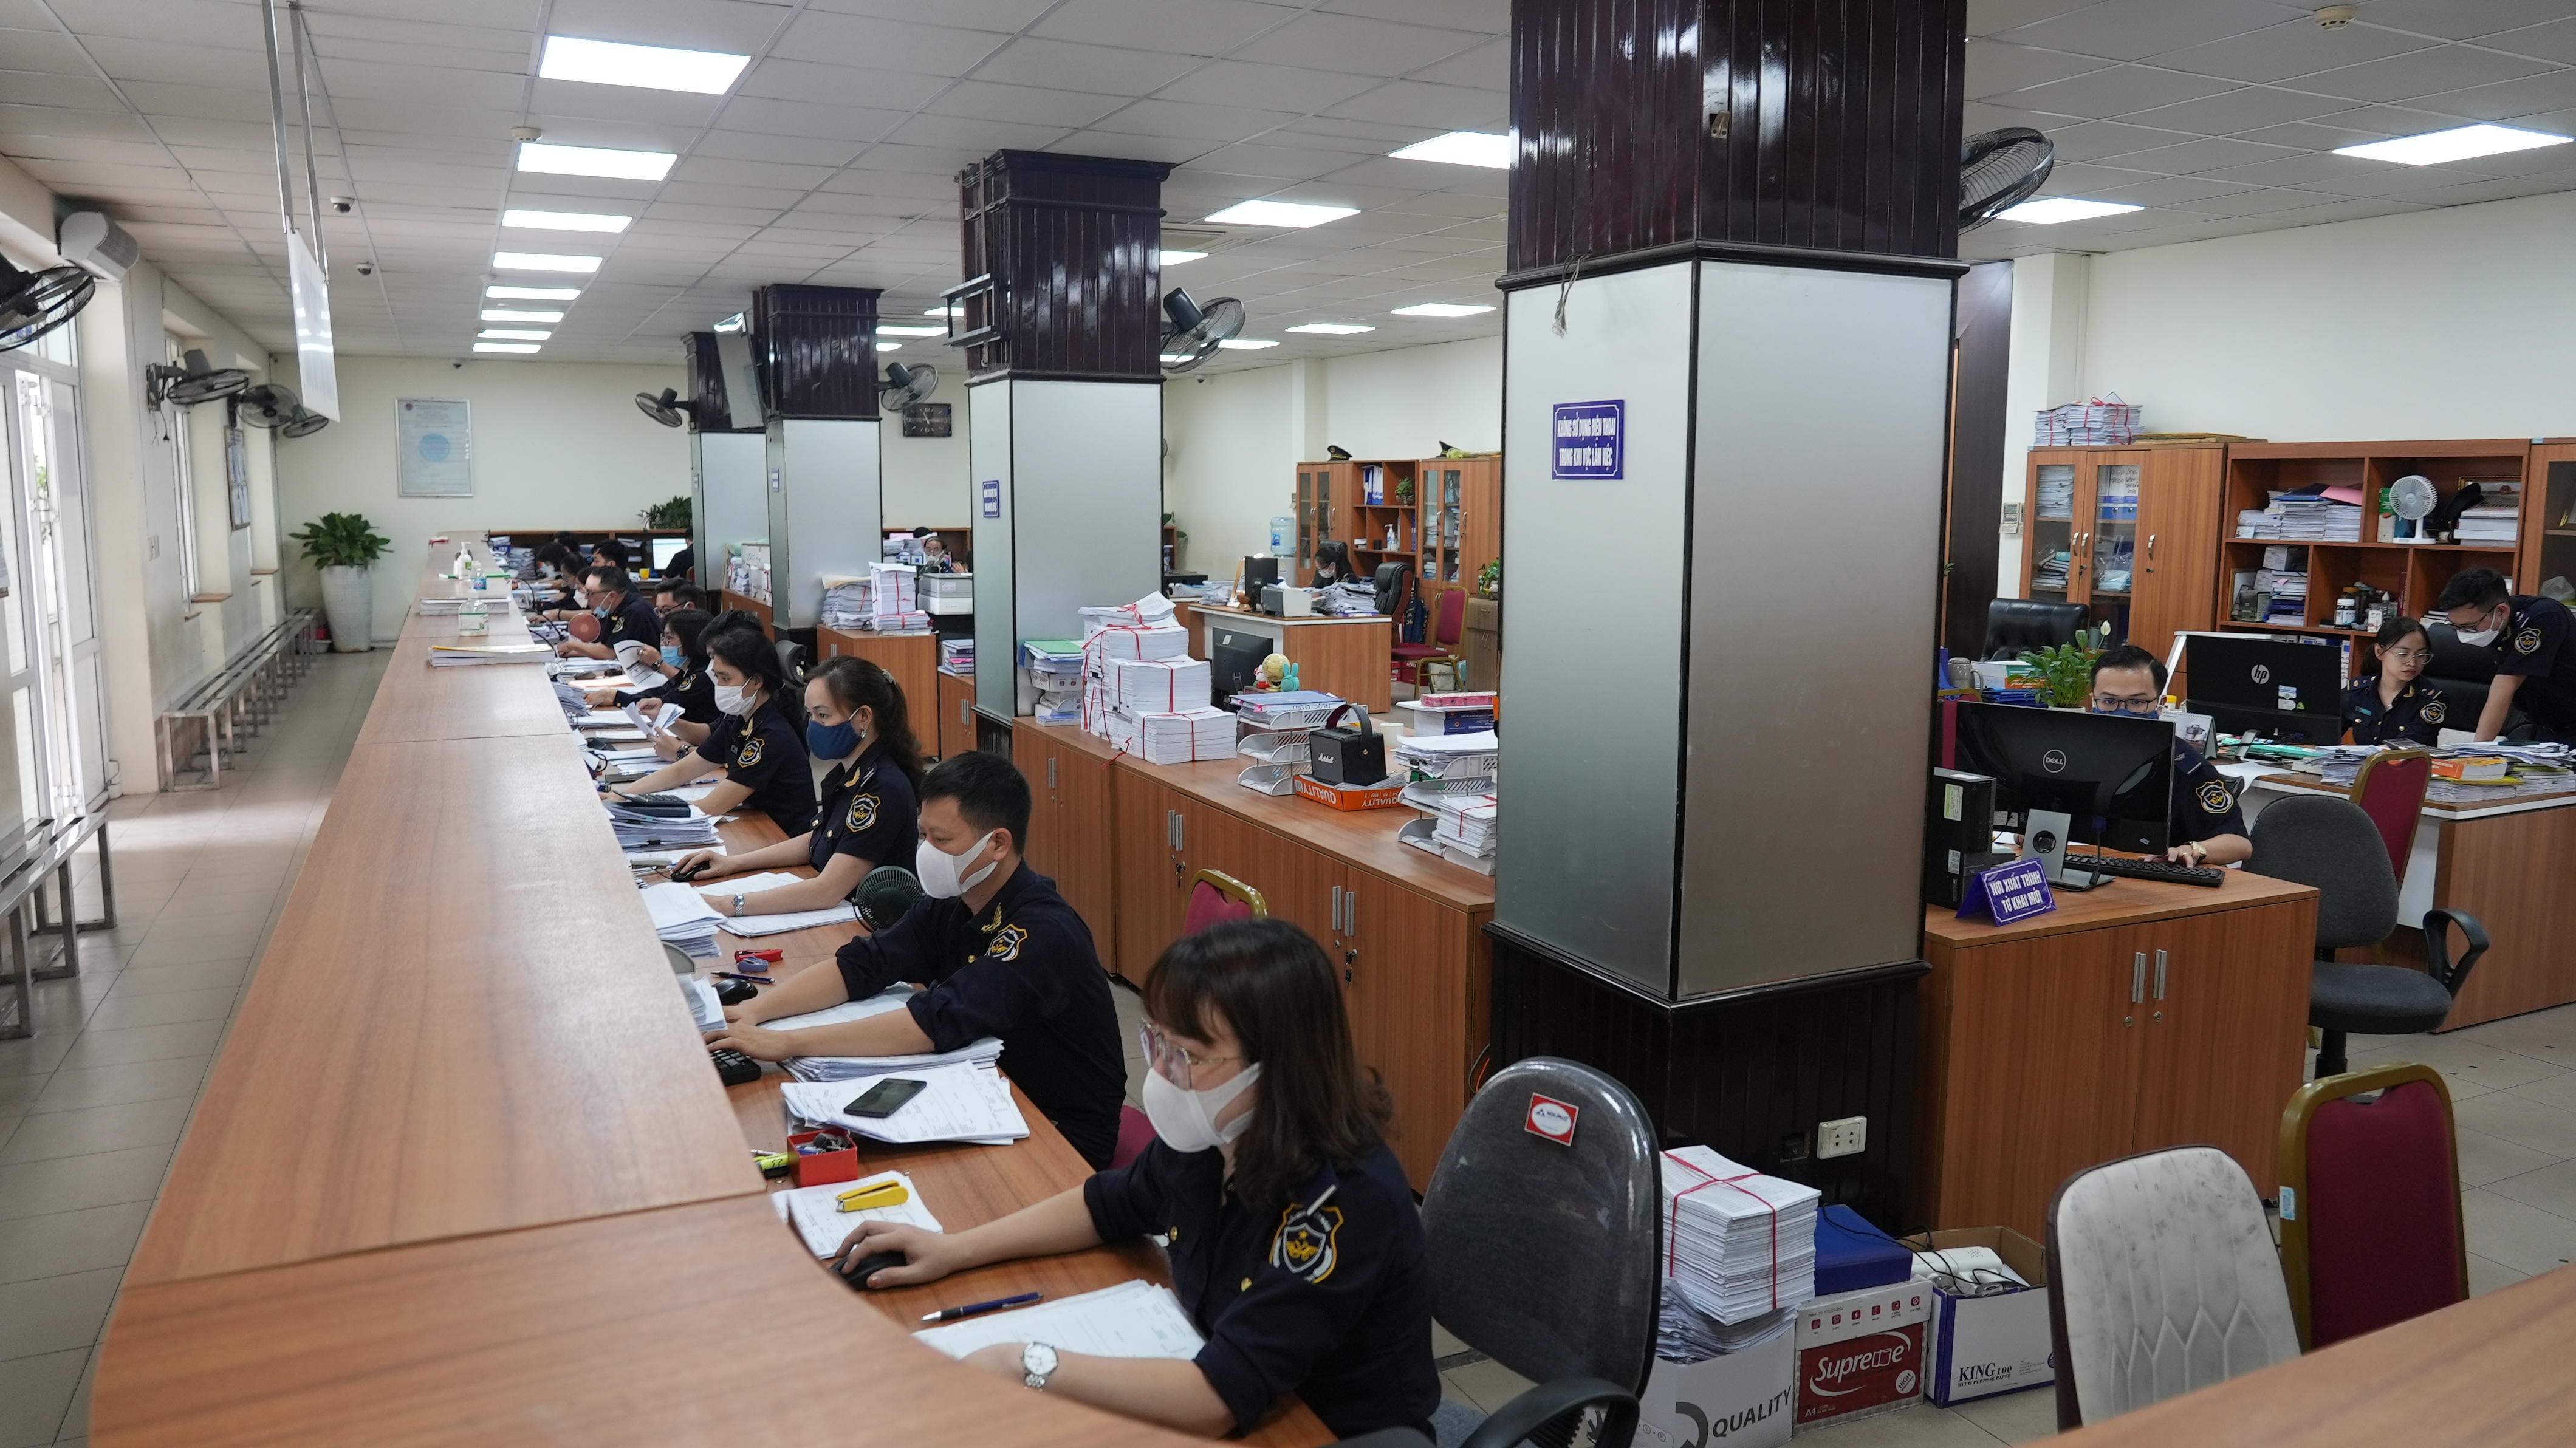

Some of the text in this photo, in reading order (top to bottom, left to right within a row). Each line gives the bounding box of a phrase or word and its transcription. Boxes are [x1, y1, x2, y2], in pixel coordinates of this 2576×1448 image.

[1559, 448, 1572, 466] TRONG
[1573, 448, 1583, 466] KHU
[2253, 664, 2267, 685] hp
[1303, 782, 1337, 804] QUALITY
[1362, 796, 1398, 807] QUALITY
[1990, 870, 2043, 896] NƠI XUẤT TRÌNH
[2001, 887, 2043, 914] TỜ KHAI MỚI
[1898, 1372, 1911, 1389] HIGH
[1959, 1362, 1995, 1382] KING
[1997, 1365, 2012, 1375] 100
[1973, 1376, 1995, 1385] PURPOSE
[1713, 1385, 1792, 1438] QUALITY
[1804, 1407, 1817, 1418] A4
